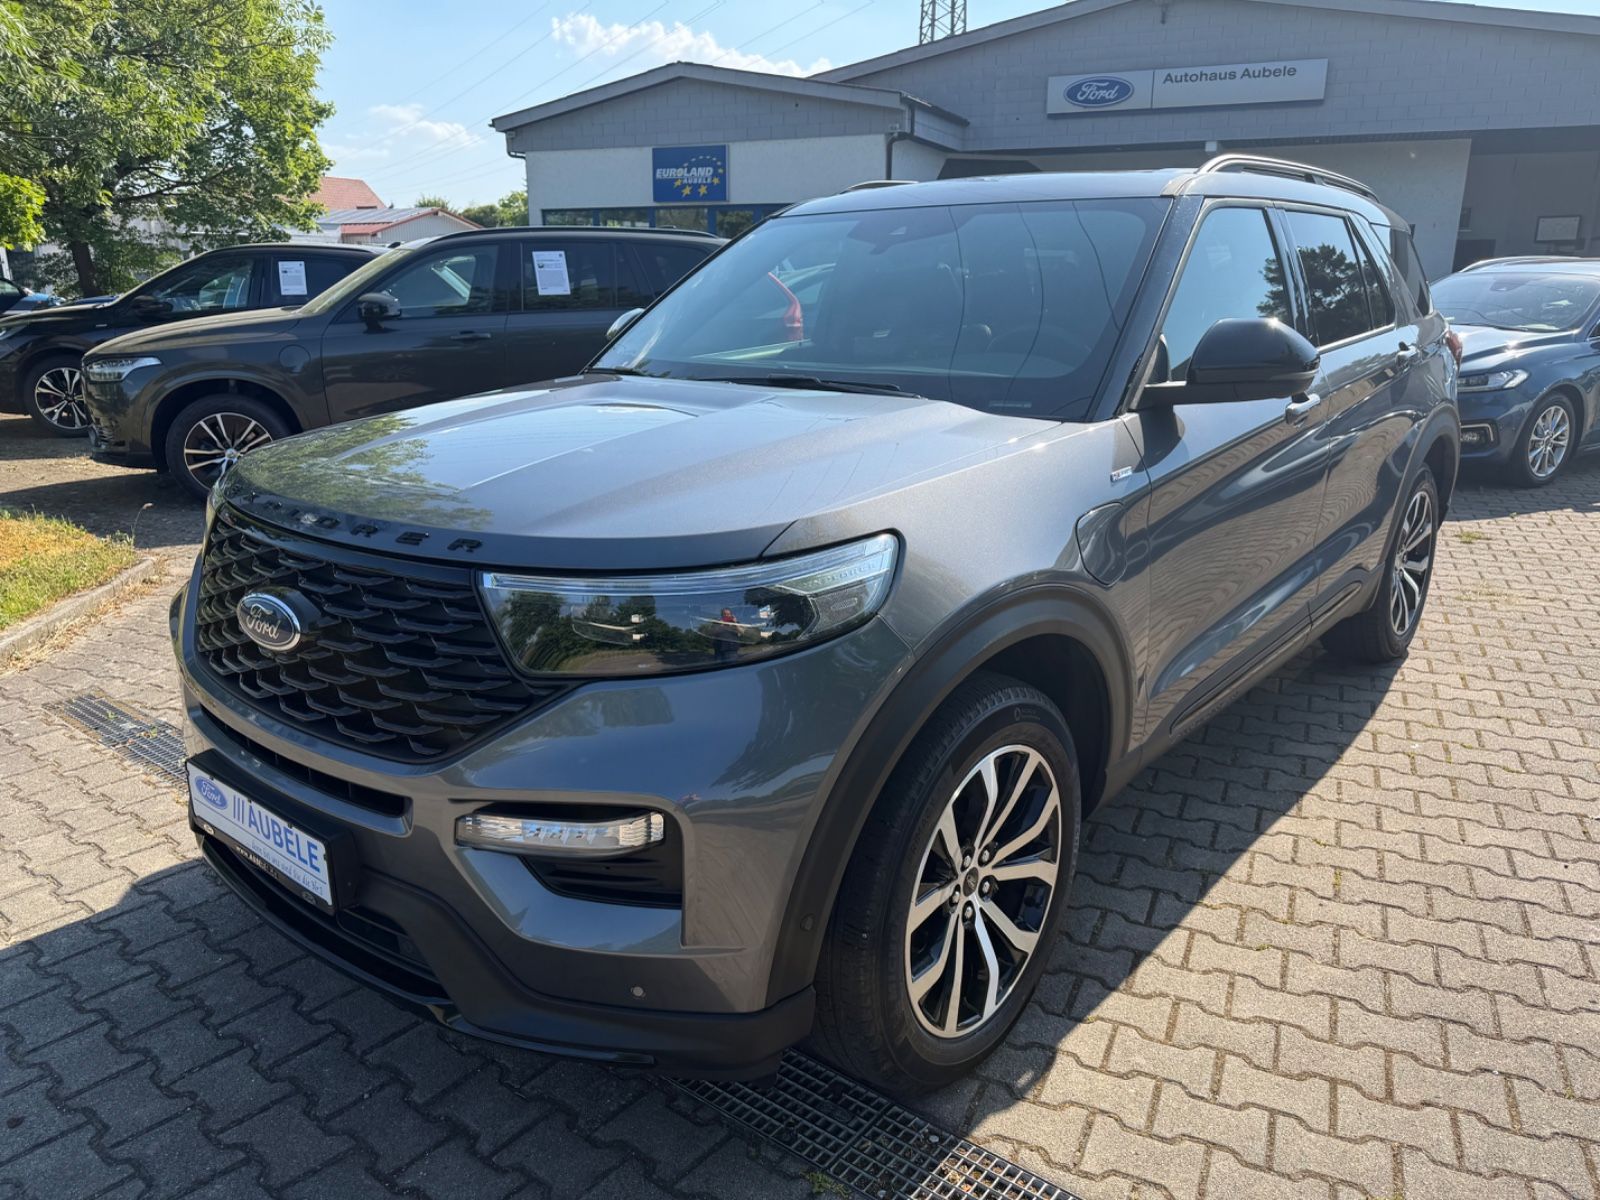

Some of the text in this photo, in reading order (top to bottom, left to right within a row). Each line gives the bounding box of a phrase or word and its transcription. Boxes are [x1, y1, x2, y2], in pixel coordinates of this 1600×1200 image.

[1162, 66, 1297, 84] Autohaus Aubele
[1077, 82, 1119, 100] Ford
[655, 167, 713, 179] EUROLAND
[246, 603, 280, 640] Ford
[248, 805, 320, 873] AUBELE
